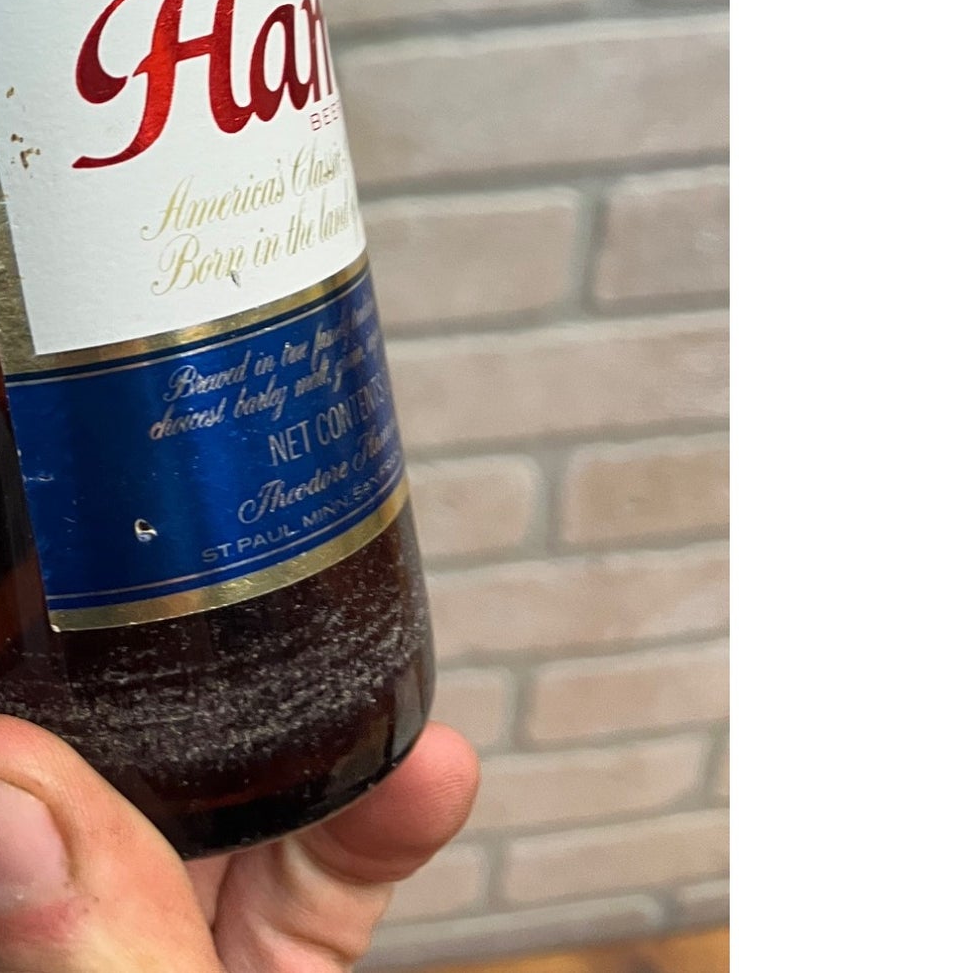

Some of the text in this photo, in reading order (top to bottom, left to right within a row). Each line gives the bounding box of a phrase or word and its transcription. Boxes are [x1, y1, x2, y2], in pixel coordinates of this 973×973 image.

[140, 159, 284, 241] America's
[151, 233, 246, 295] Born
[253, 227, 281, 267] in
[285, 199, 316, 255] the
[148, 397, 227, 440] choicest
[233, 374, 288, 421] barley
[162, 350, 253, 403] Brewed
[254, 351, 277, 376] in
[267, 420, 310, 467] NET
[237, 460, 349, 524] Theodore
